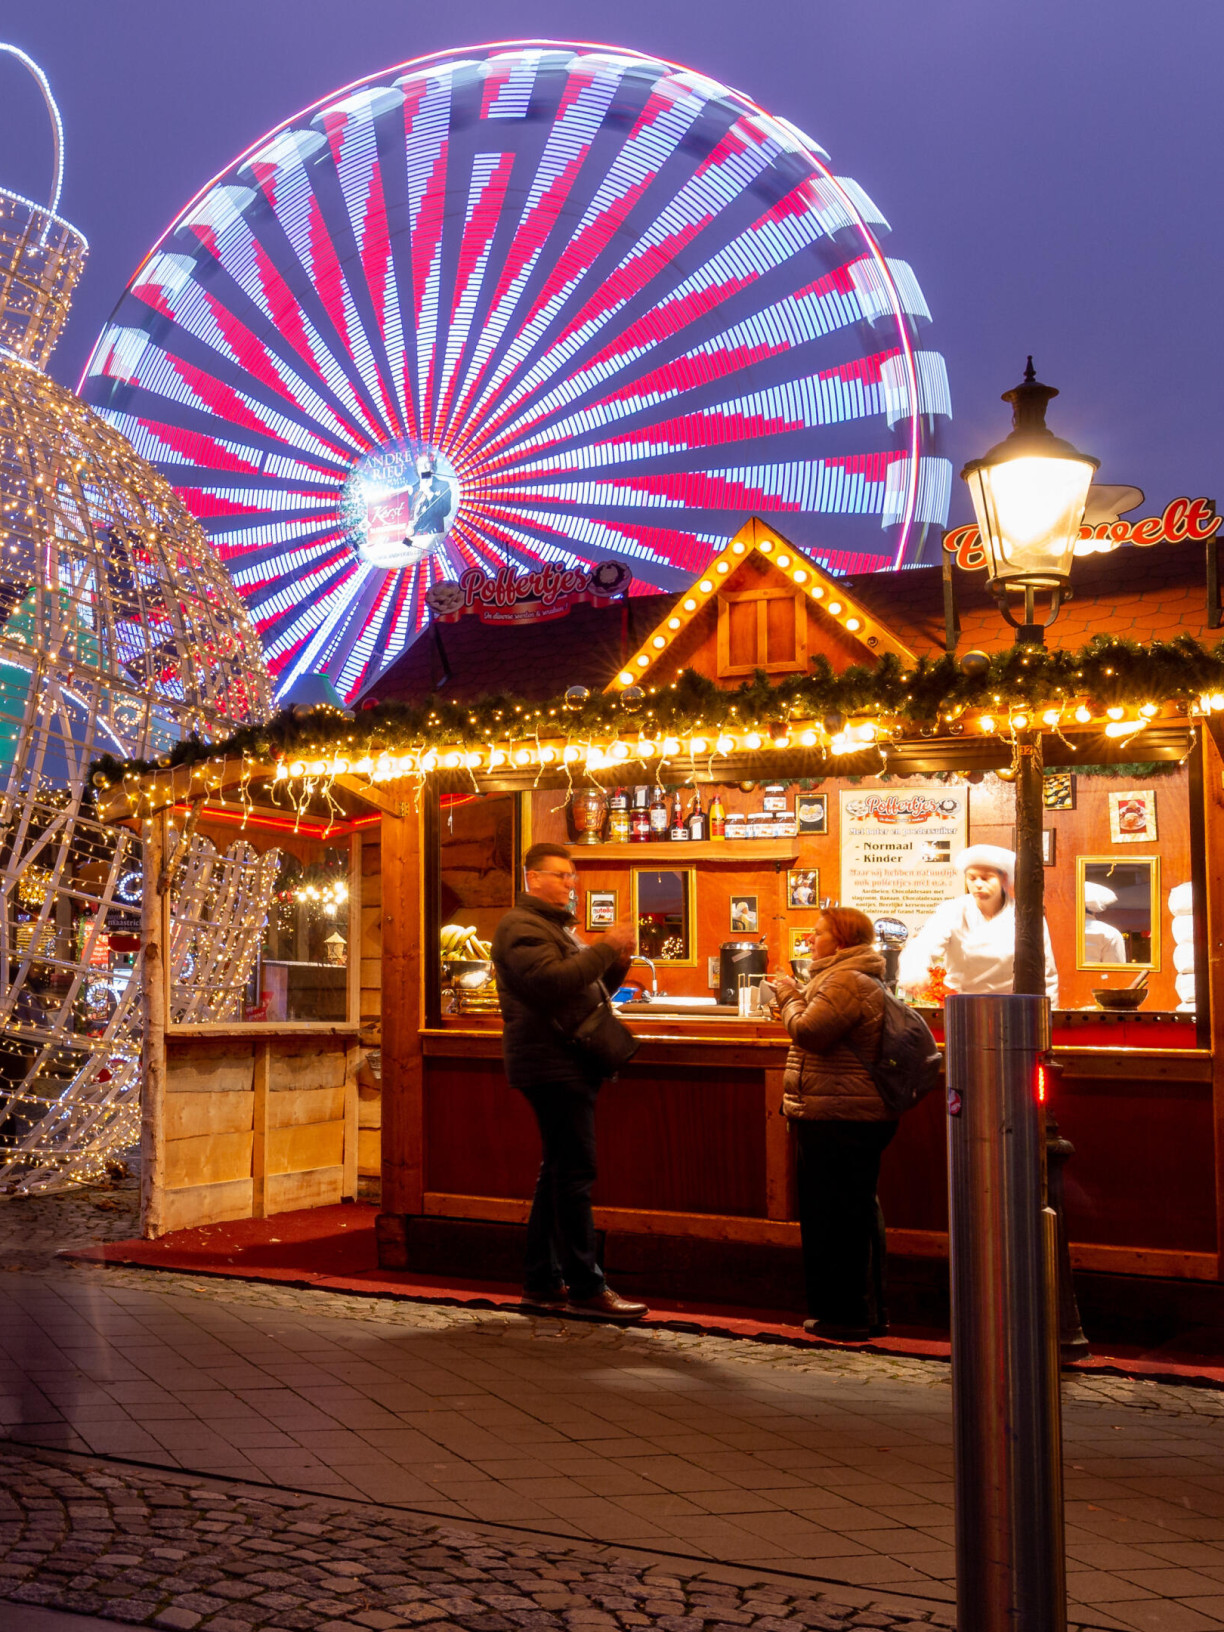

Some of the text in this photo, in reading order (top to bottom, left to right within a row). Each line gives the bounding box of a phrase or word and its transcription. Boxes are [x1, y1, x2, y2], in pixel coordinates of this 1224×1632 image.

[363, 448, 413, 469] ANDRÉ
[372, 461, 406, 480] RIEU
[943, 496, 1224, 570] Bwelt
[460, 561, 591, 606] Poffertjes
[865, 795, 937, 816] Poffertjes
[863, 842, 913, 850] Normaal
[863, 854, 903, 863] Kinder
